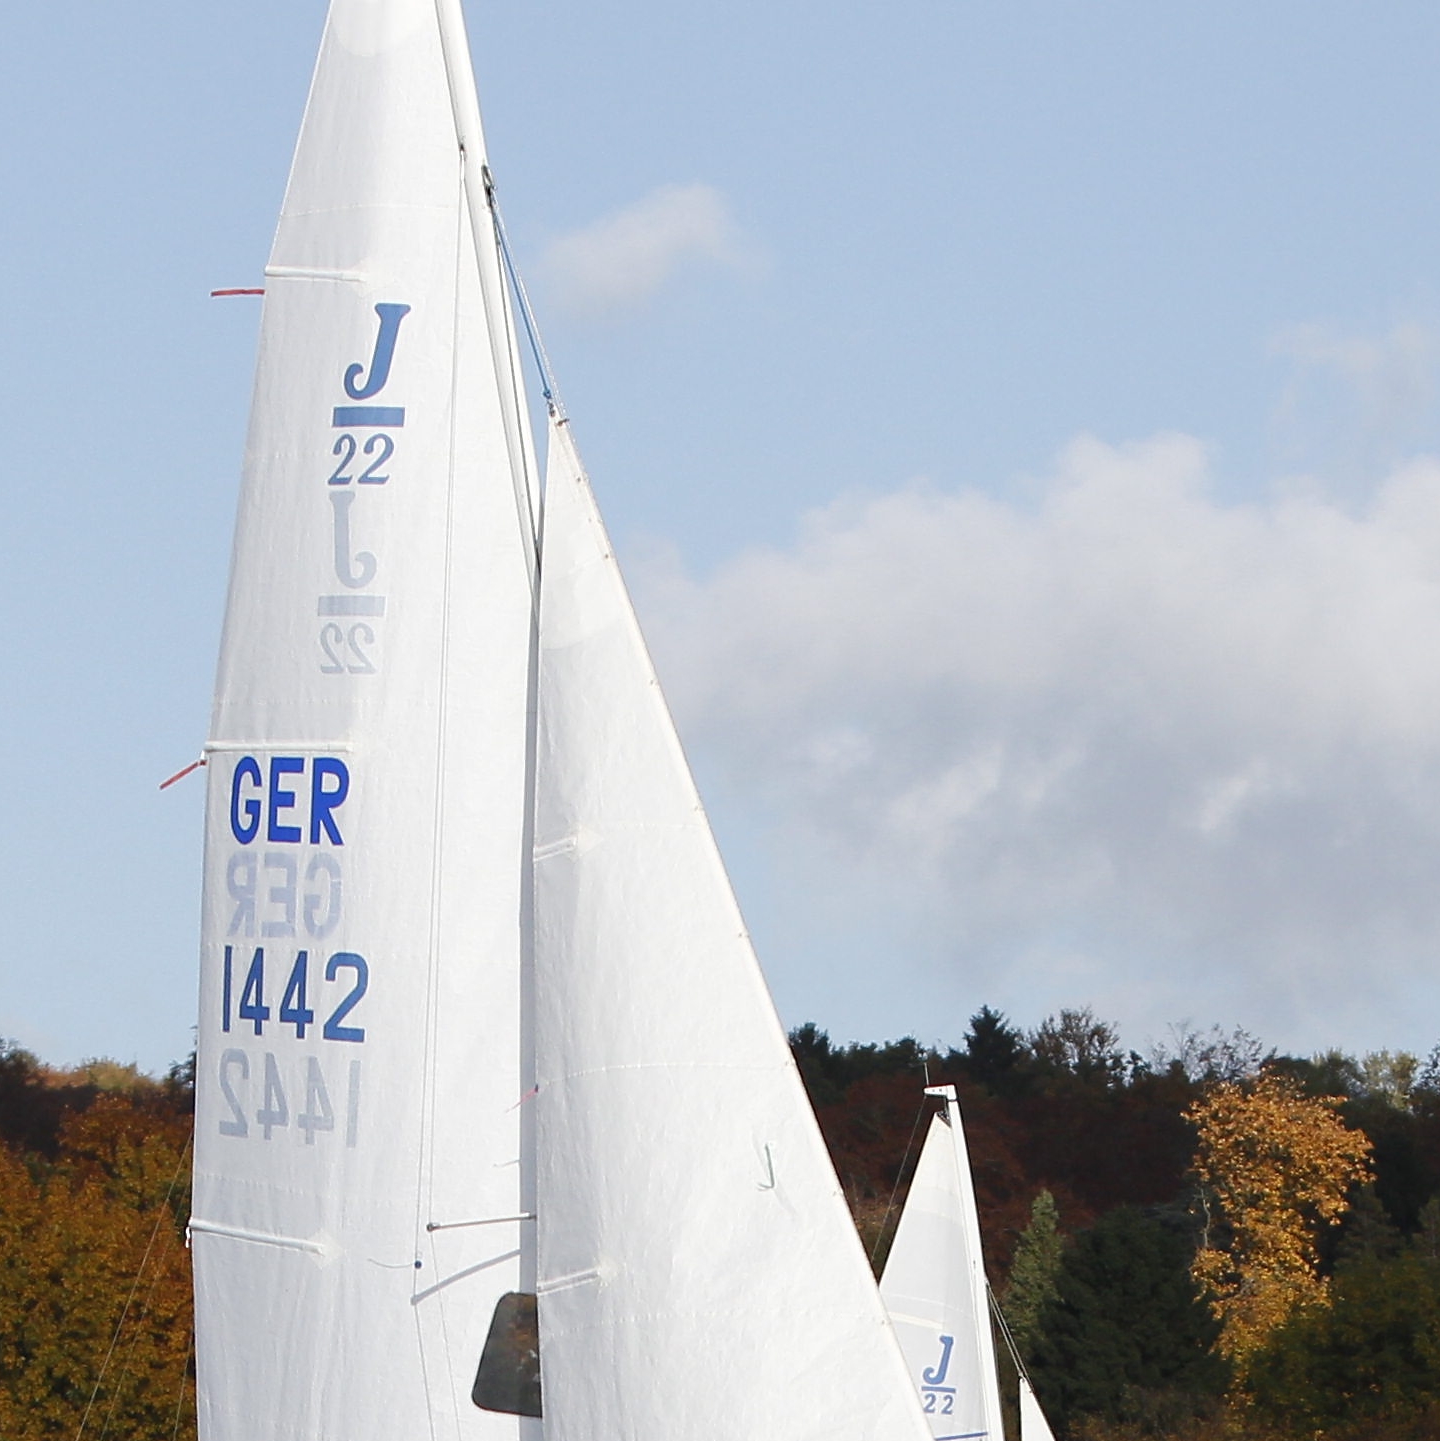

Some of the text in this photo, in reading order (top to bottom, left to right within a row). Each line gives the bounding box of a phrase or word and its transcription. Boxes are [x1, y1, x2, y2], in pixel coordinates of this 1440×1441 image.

[343, 303, 411, 400] J
[327, 433, 395, 486] 22
[230, 756, 350, 845] GER
[222, 945, 369, 1043] 1442
[922, 1335, 954, 1385] J
[923, 1393, 954, 1415] 22
